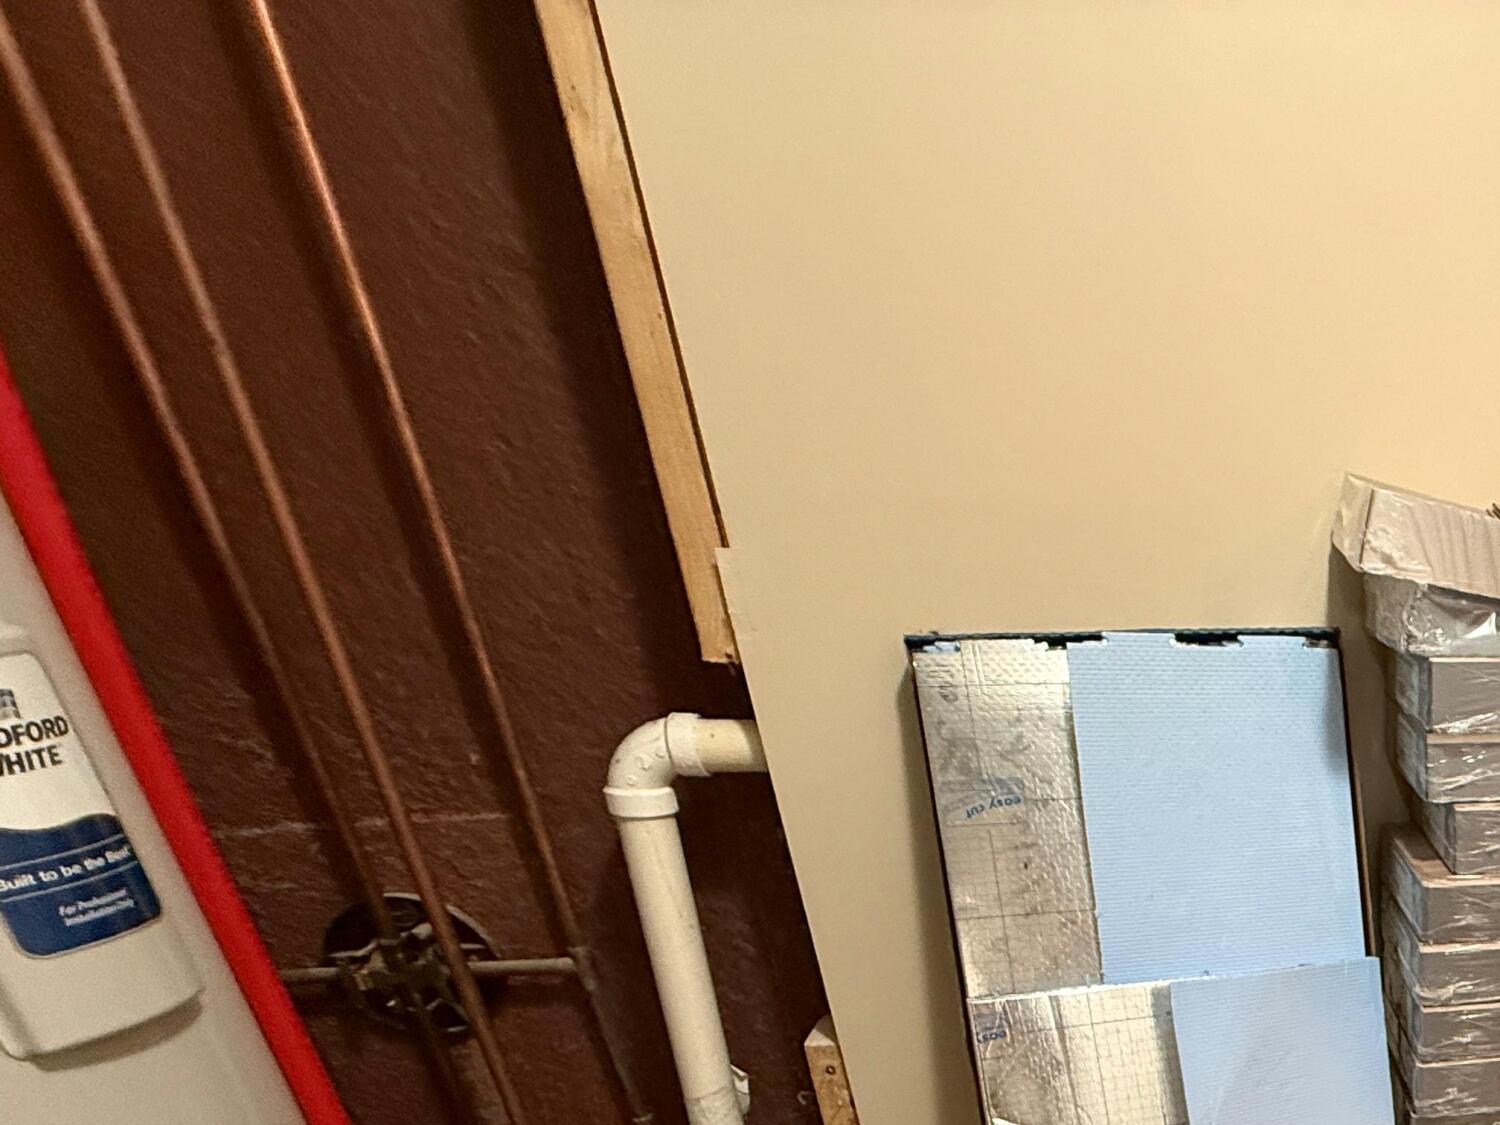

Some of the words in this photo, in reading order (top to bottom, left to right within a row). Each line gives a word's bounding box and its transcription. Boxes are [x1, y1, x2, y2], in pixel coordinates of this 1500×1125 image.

[965, 804, 985, 820] cut
[988, 795, 1022, 812] easy
[38, 870, 59, 882] to
[60, 863, 82, 877] be
